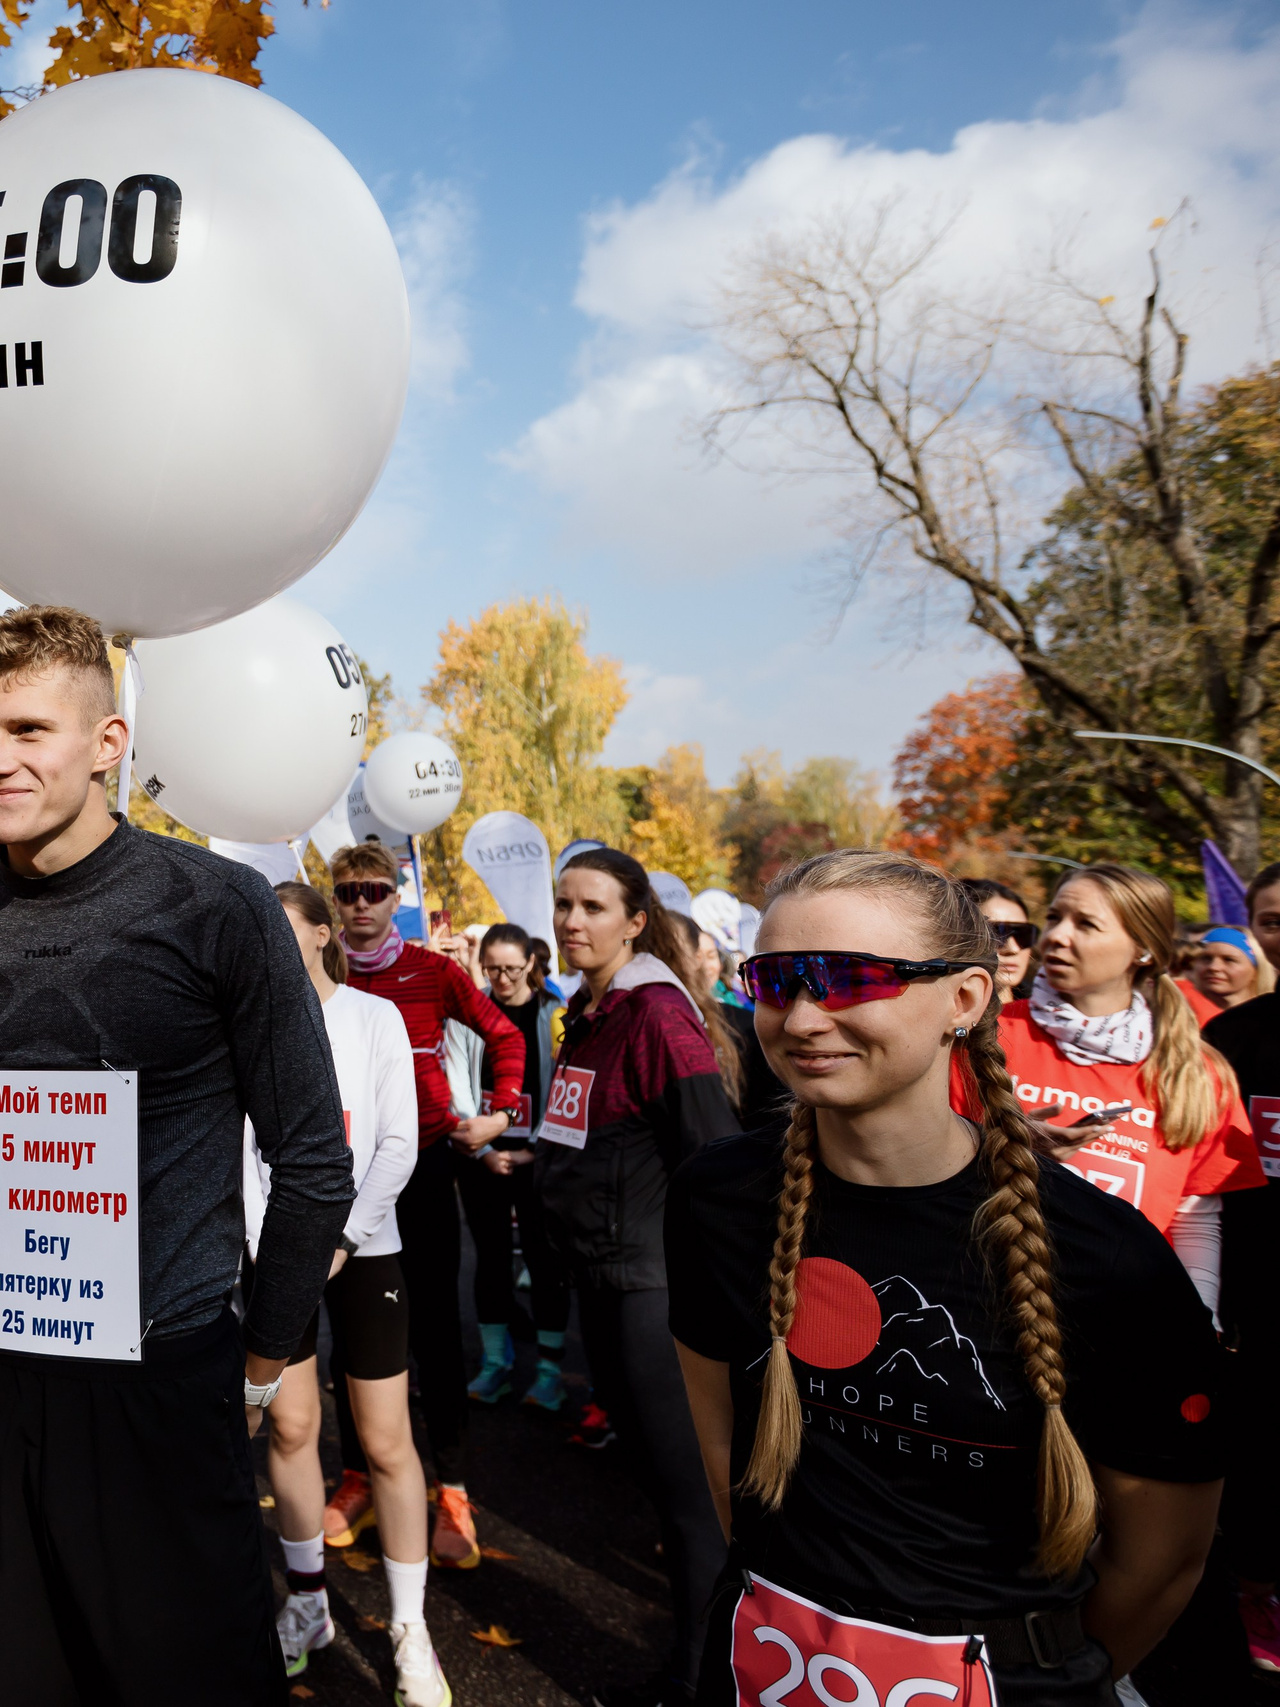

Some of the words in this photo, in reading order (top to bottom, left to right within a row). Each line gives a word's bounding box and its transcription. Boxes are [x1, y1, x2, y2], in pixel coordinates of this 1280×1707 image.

[48, 1092, 107, 1115] темп
[1, 1133, 15, 1162] 5
[23, 1140, 97, 1171] минут
[8, 1188, 128, 1223] километр
[24, 1229, 71, 1261] Бегу
[79, 1279, 104, 1300] из
[1, 1308, 25, 1335] 25
[32, 1317, 95, 1346] минут
[809, 1376, 929, 1424] HOPE
